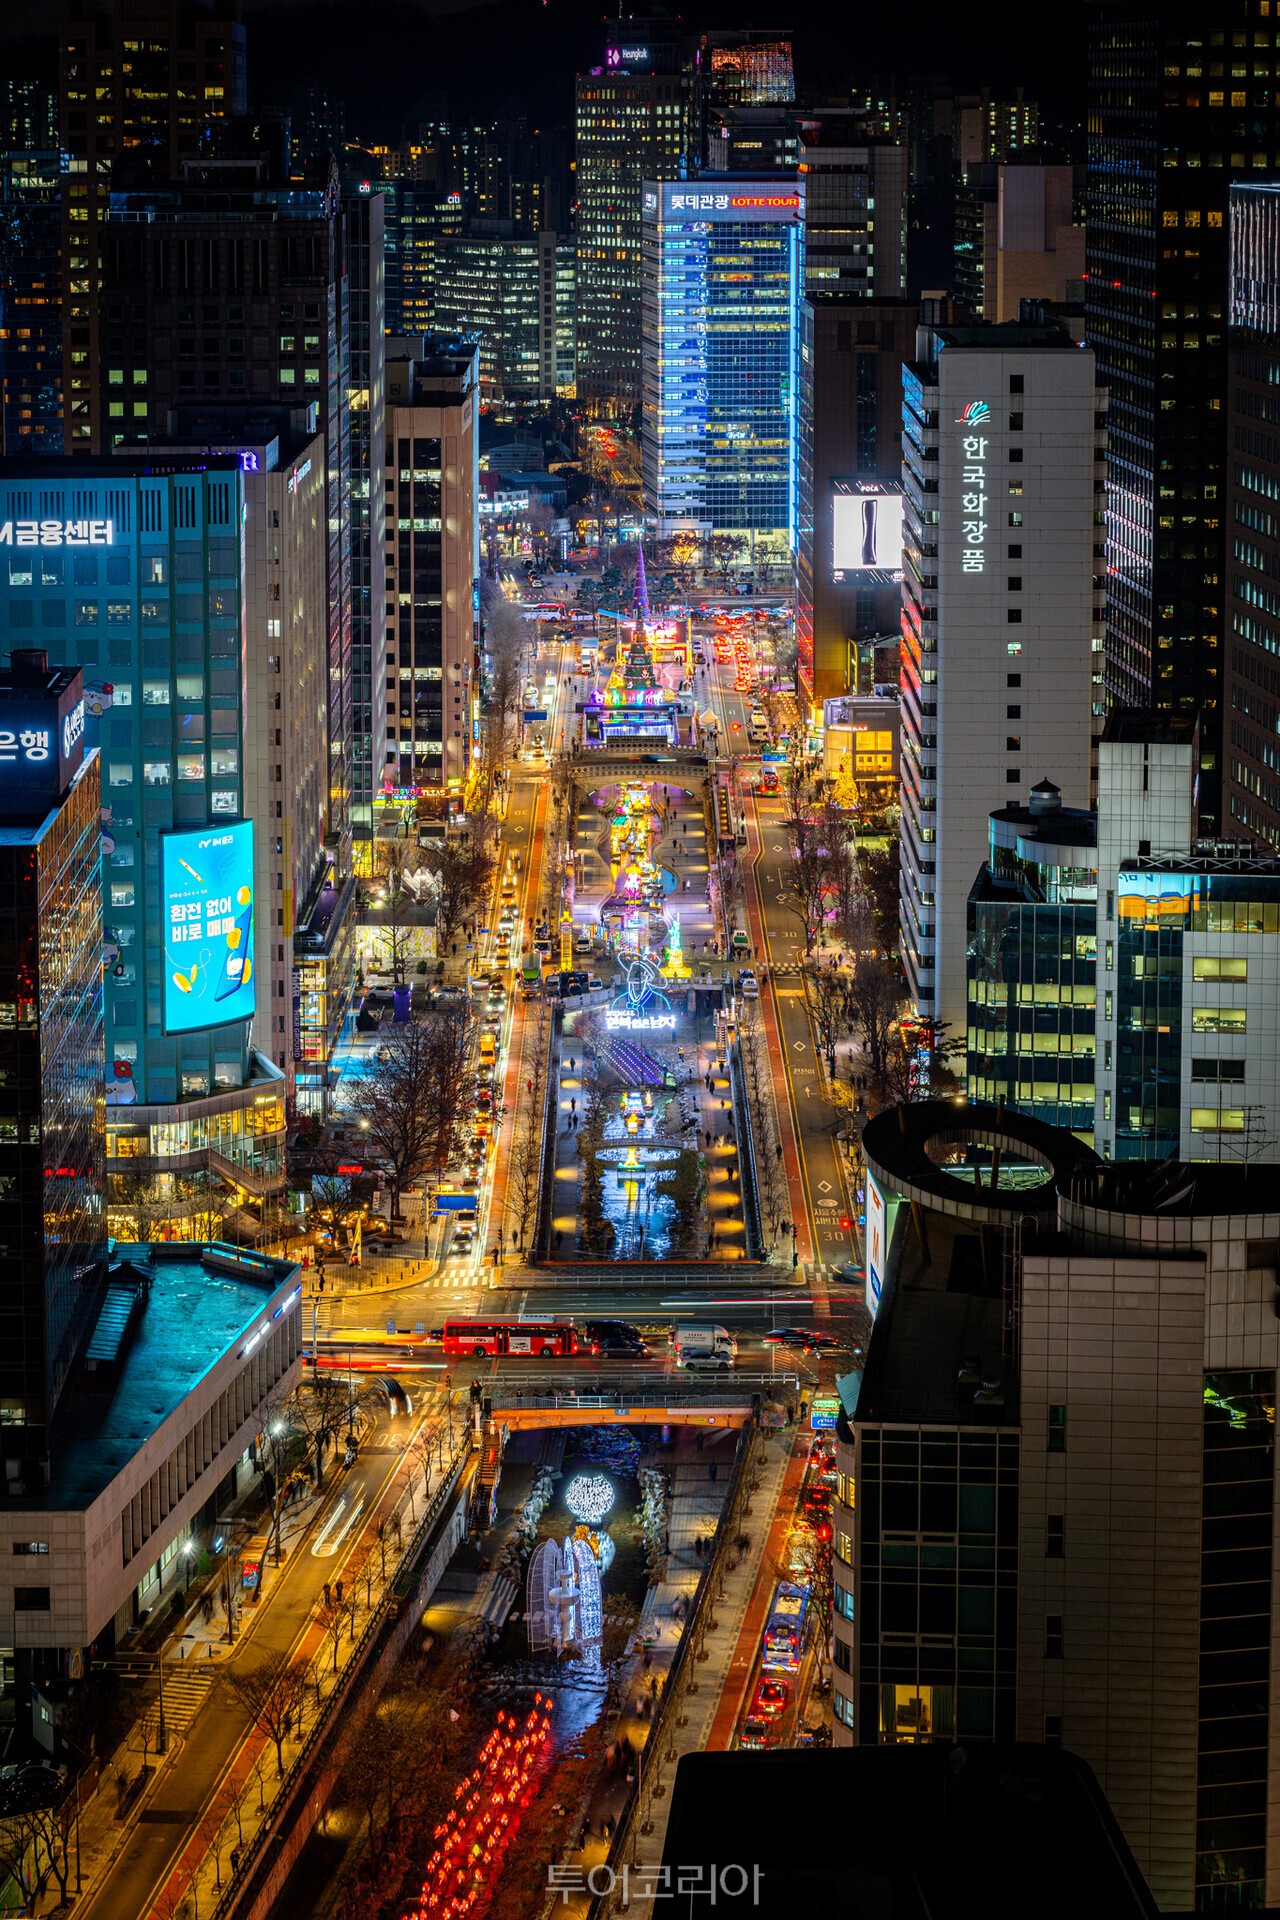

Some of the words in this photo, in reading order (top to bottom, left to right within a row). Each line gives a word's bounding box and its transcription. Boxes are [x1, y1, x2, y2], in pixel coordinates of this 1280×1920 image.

[622, 48, 648, 60] Heungkuk
[447, 194, 460, 204] citi
[671, 194, 730, 210] 롯데관광
[732, 197, 764, 206] LOTTE
[765, 197, 798, 206] TOUR
[861, 485, 879, 493] POLA
[961, 435, 988, 573] 한국화장품
[0, 730, 49, 761] 은행
[421, 789, 445, 797] TEXAS
[170, 901, 202, 923] 환전
[205, 895, 232, 918] 없이
[171, 922, 202, 943] 바로
[206, 915, 236, 938] 매매
[823, 1231, 844, 1241] 30
[374, 1432, 402, 1449] 30
